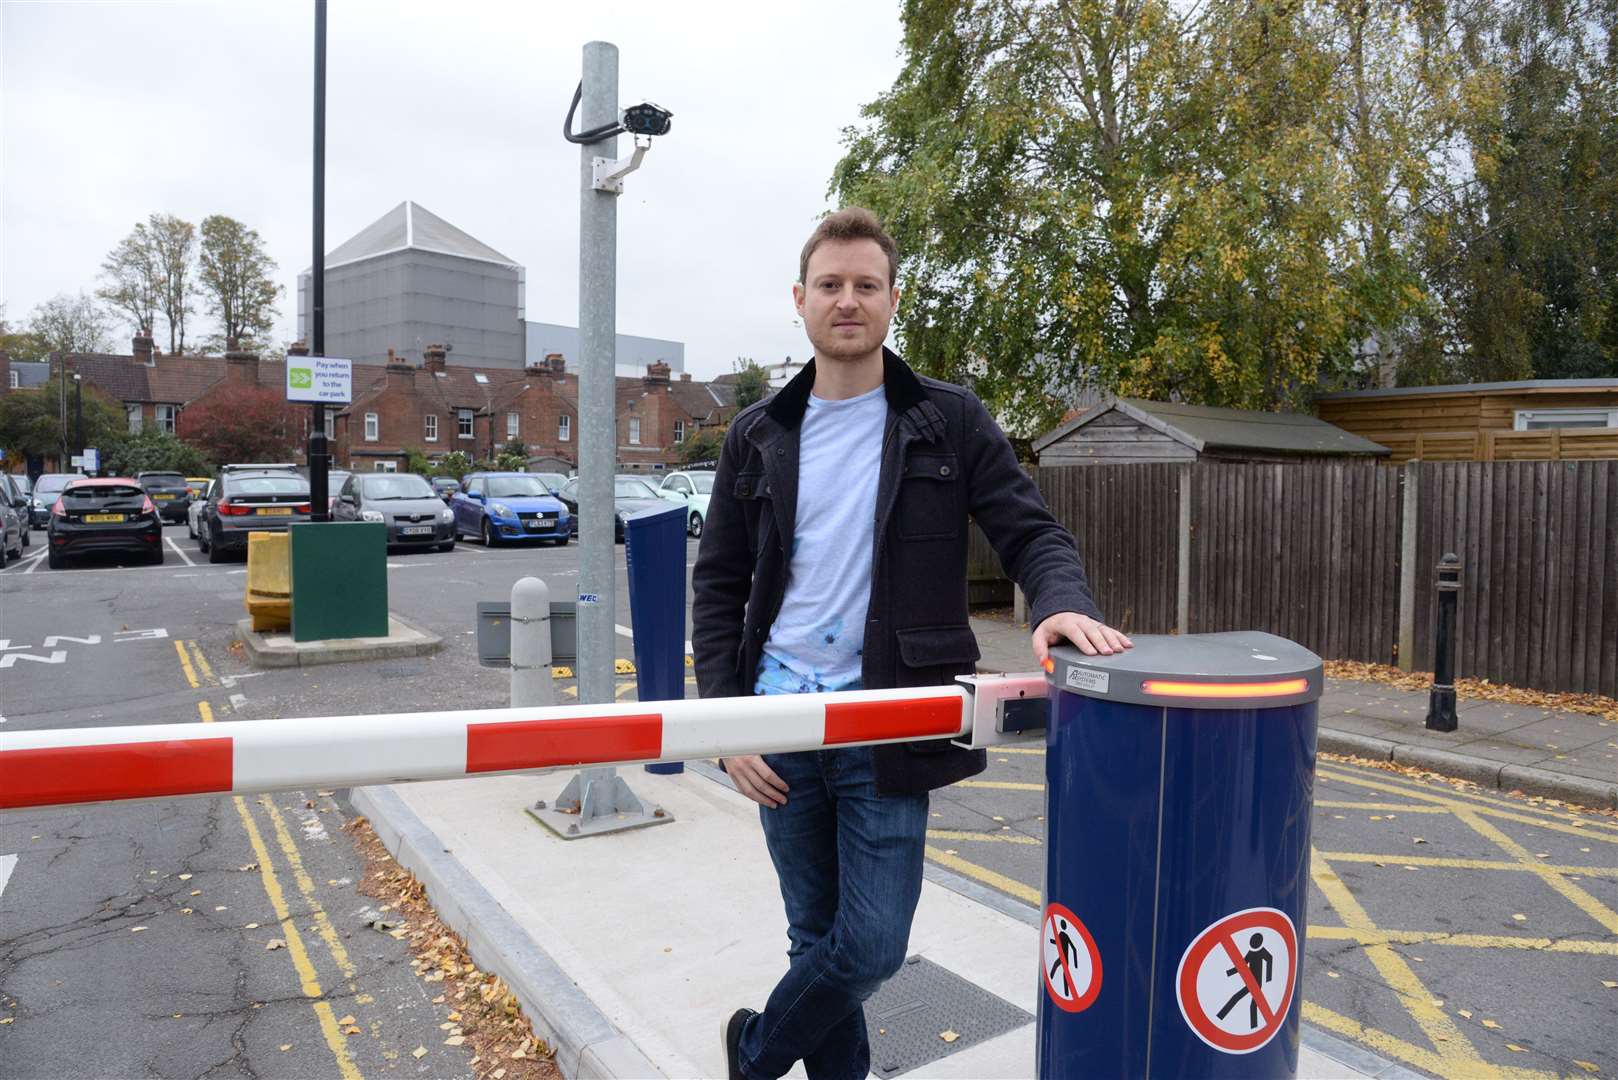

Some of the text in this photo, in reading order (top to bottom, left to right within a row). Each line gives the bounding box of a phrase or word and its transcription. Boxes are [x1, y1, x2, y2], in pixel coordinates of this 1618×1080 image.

[316, 361, 328, 370] Pay
[329, 371, 350, 379] return
[330, 391, 345, 399] park
[1078, 670, 1107, 681] AUTOMATIC
